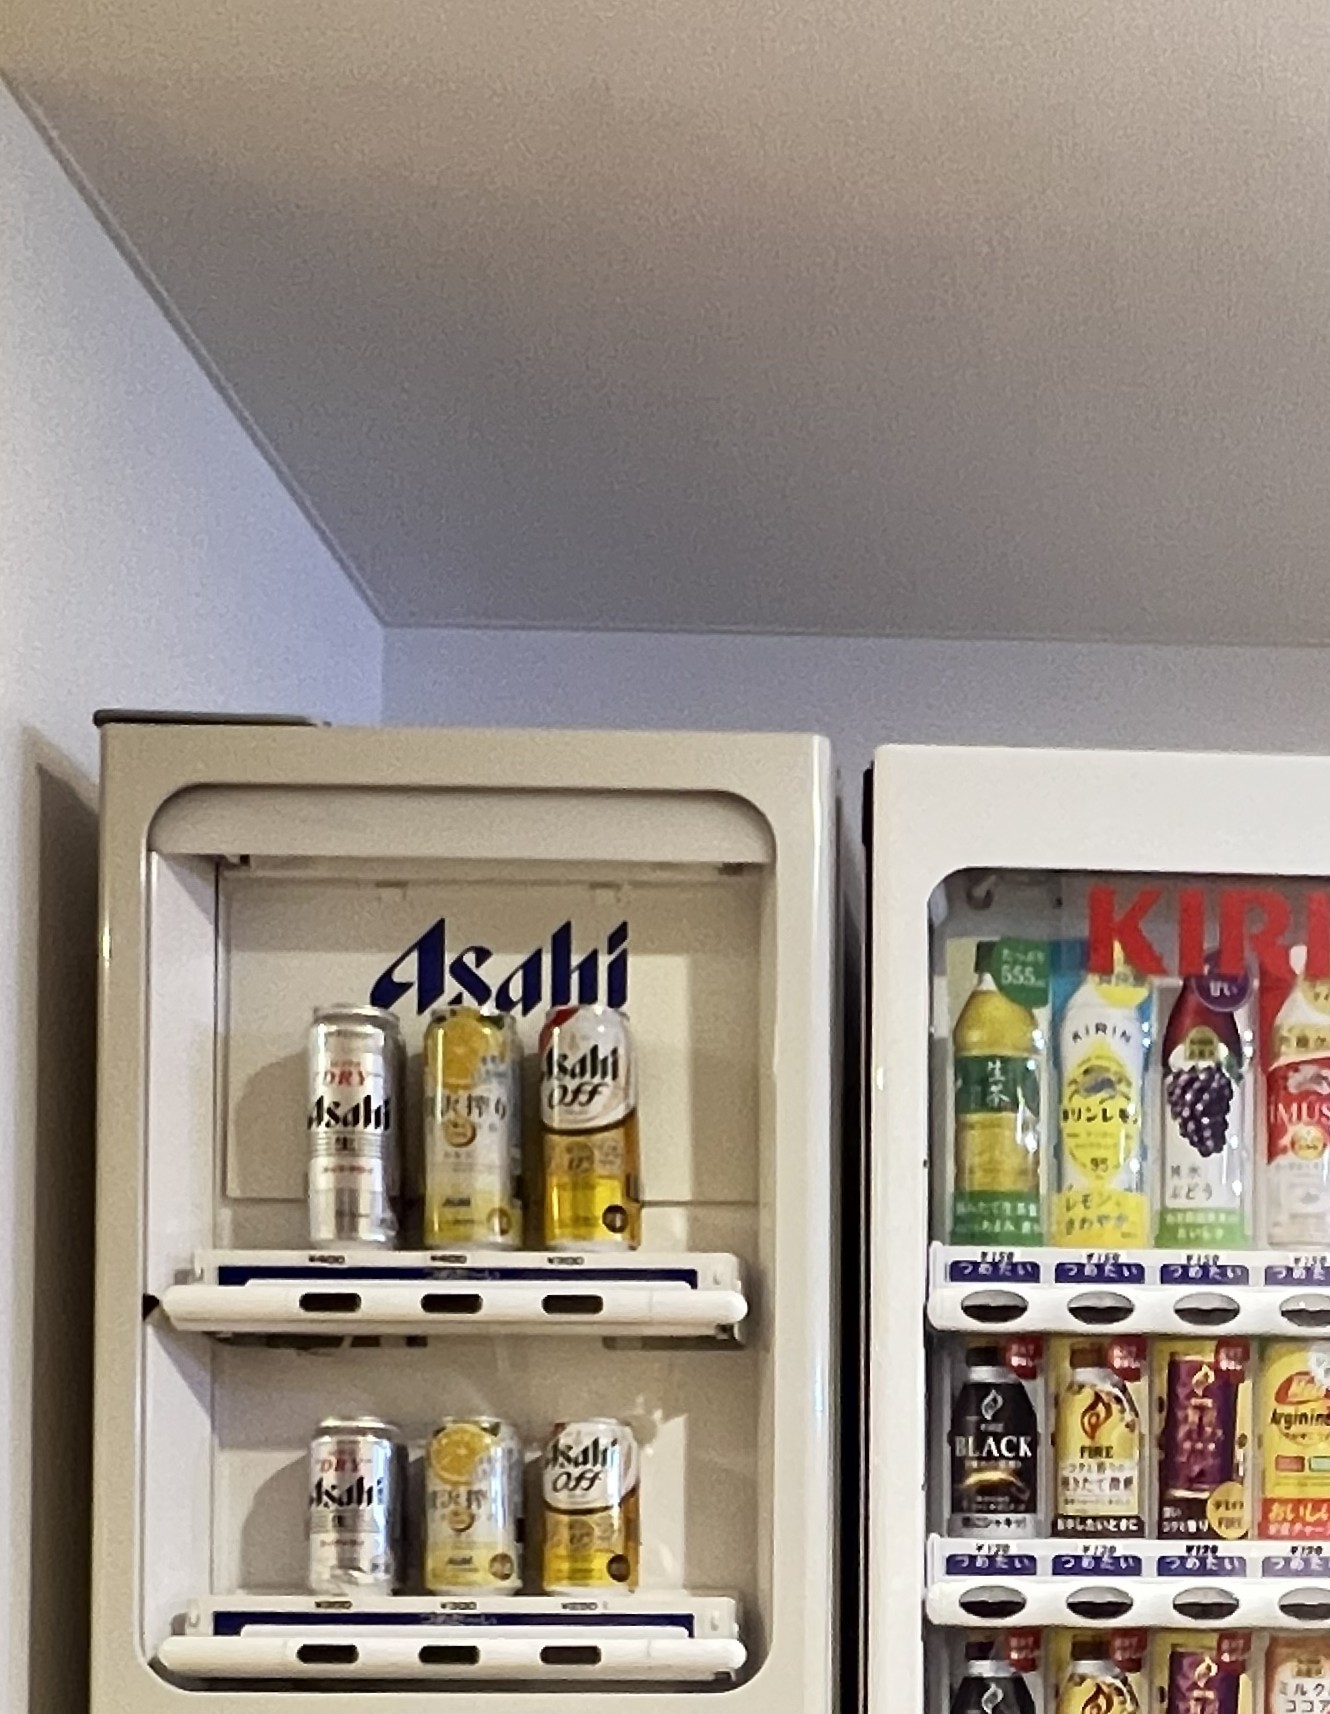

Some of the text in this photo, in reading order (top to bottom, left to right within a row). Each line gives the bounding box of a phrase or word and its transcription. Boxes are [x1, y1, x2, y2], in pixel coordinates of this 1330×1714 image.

[369, 917, 629, 1016] Asahi
[1071, 1022, 1132, 1044] KIRIN
[544, 1045, 619, 1082] Asahi
[307, 1094, 391, 1132] Asahi
[960, 1263, 1034, 1279] つめたい
[1066, 1264, 1138, 1279] つめたい
[1170, 1265, 1243, 1280] つめたい
[544, 1438, 619, 1469] Asahi
[954, 1435, 1033, 1458] BLACK
[954, 1555, 1030, 1569] つめたい
[1061, 1556, 1135, 1570] つめたい
[1166, 1556, 1240, 1570] つめたい
